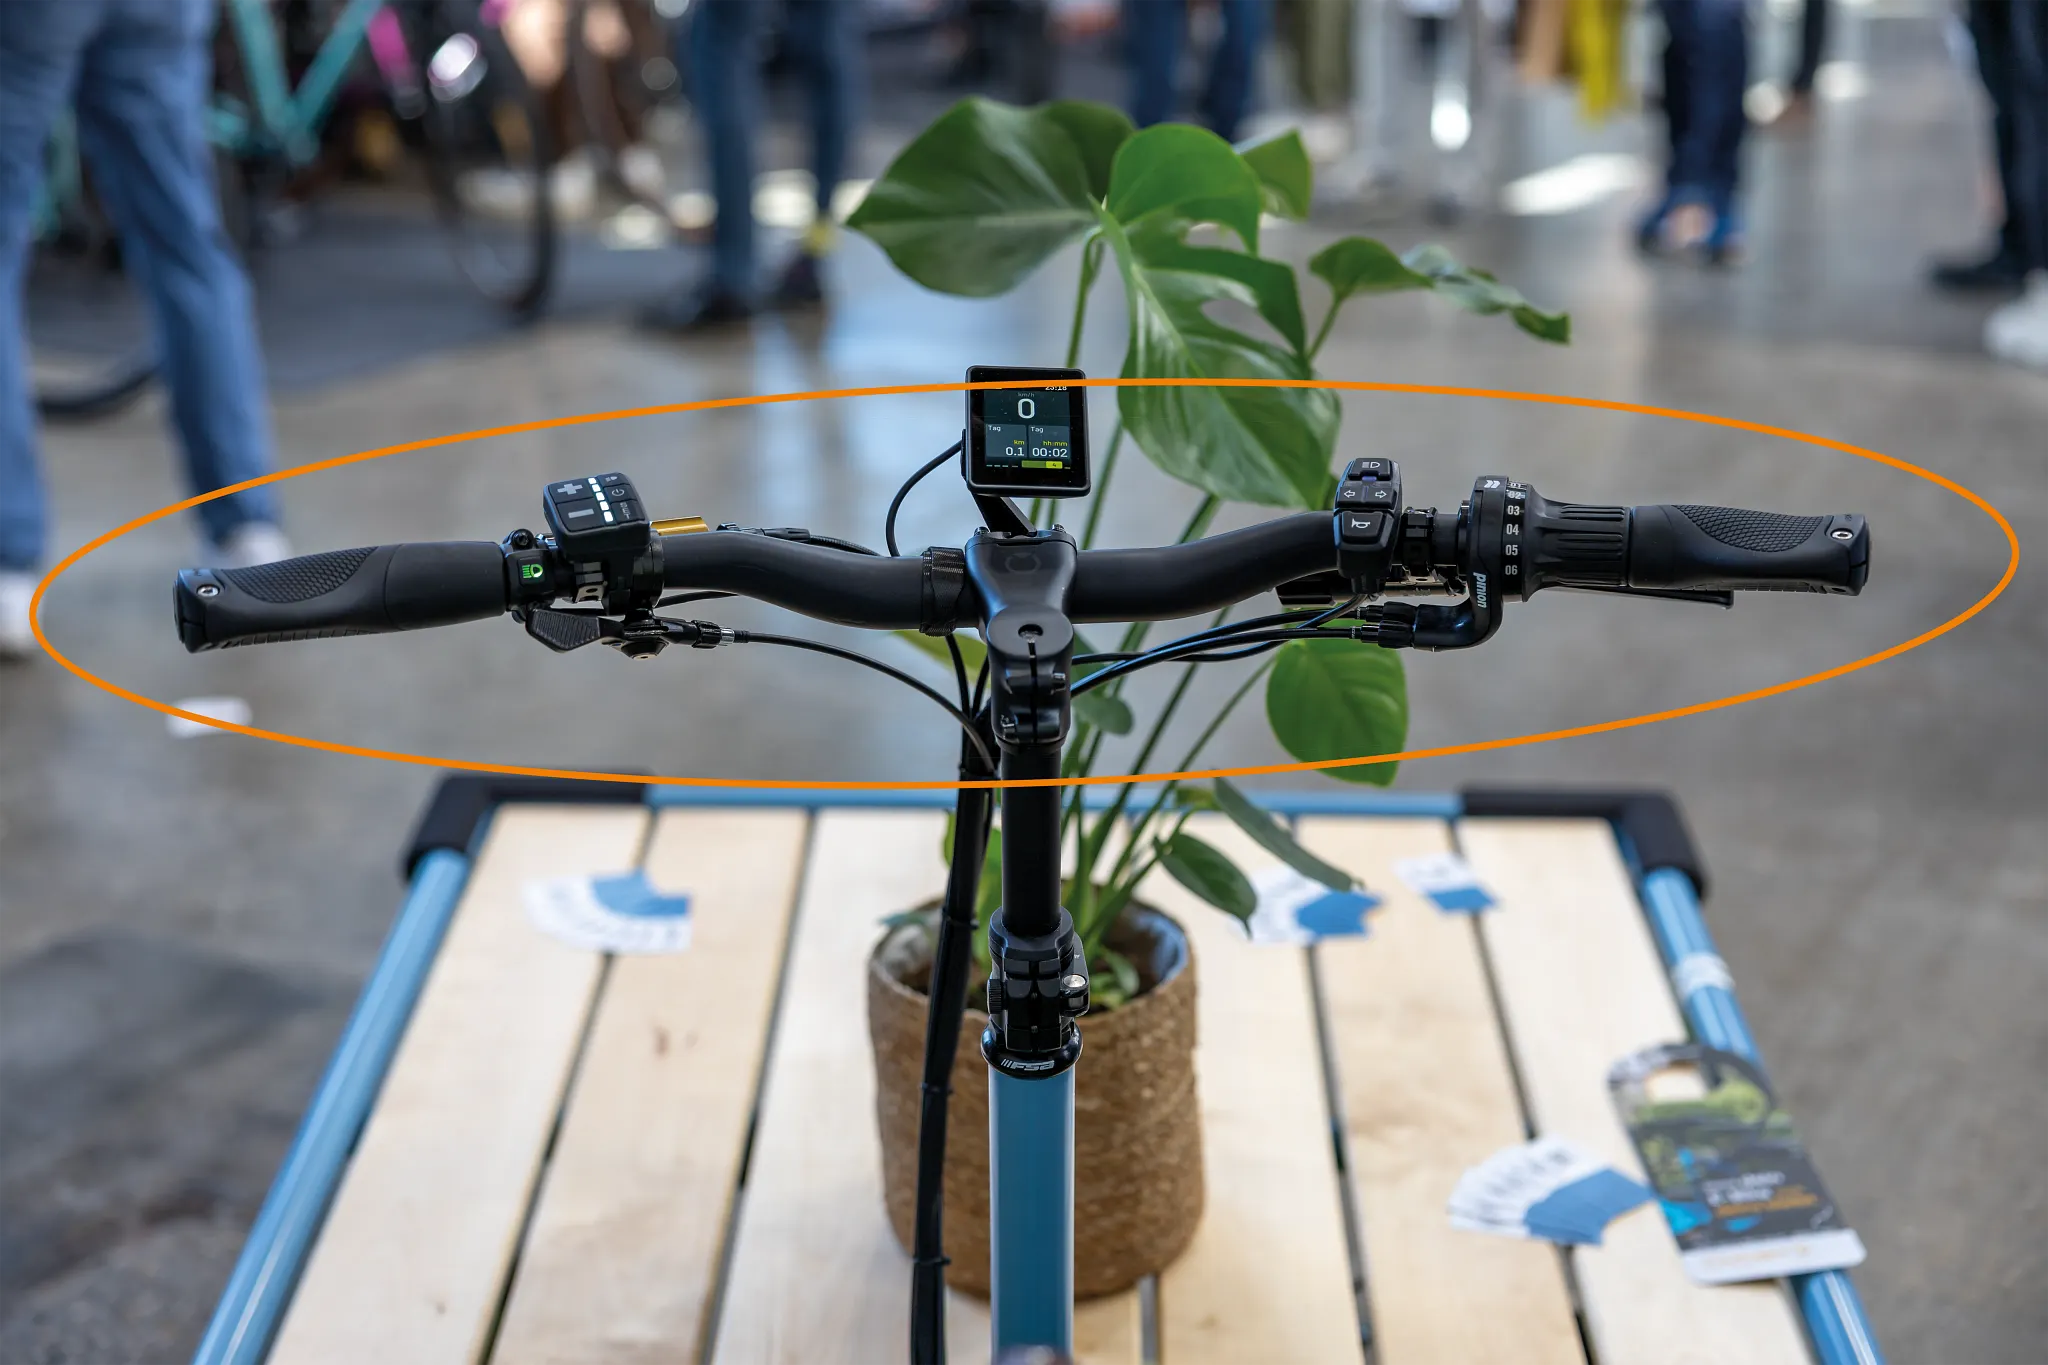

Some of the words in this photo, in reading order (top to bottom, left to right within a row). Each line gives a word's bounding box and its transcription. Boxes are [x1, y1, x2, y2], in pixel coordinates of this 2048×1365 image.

[1018, 398, 1035, 419] 0
[1005, 447, 1024, 456] 0.1
[1032, 447, 1068, 458] 00:02
[1507, 505, 1520, 516] 03
[1506, 524, 1519, 535] 04
[1505, 545, 1518, 556] 05
[1505, 564, 1518, 575] 06
[1473, 571, 1487, 608] pinion
